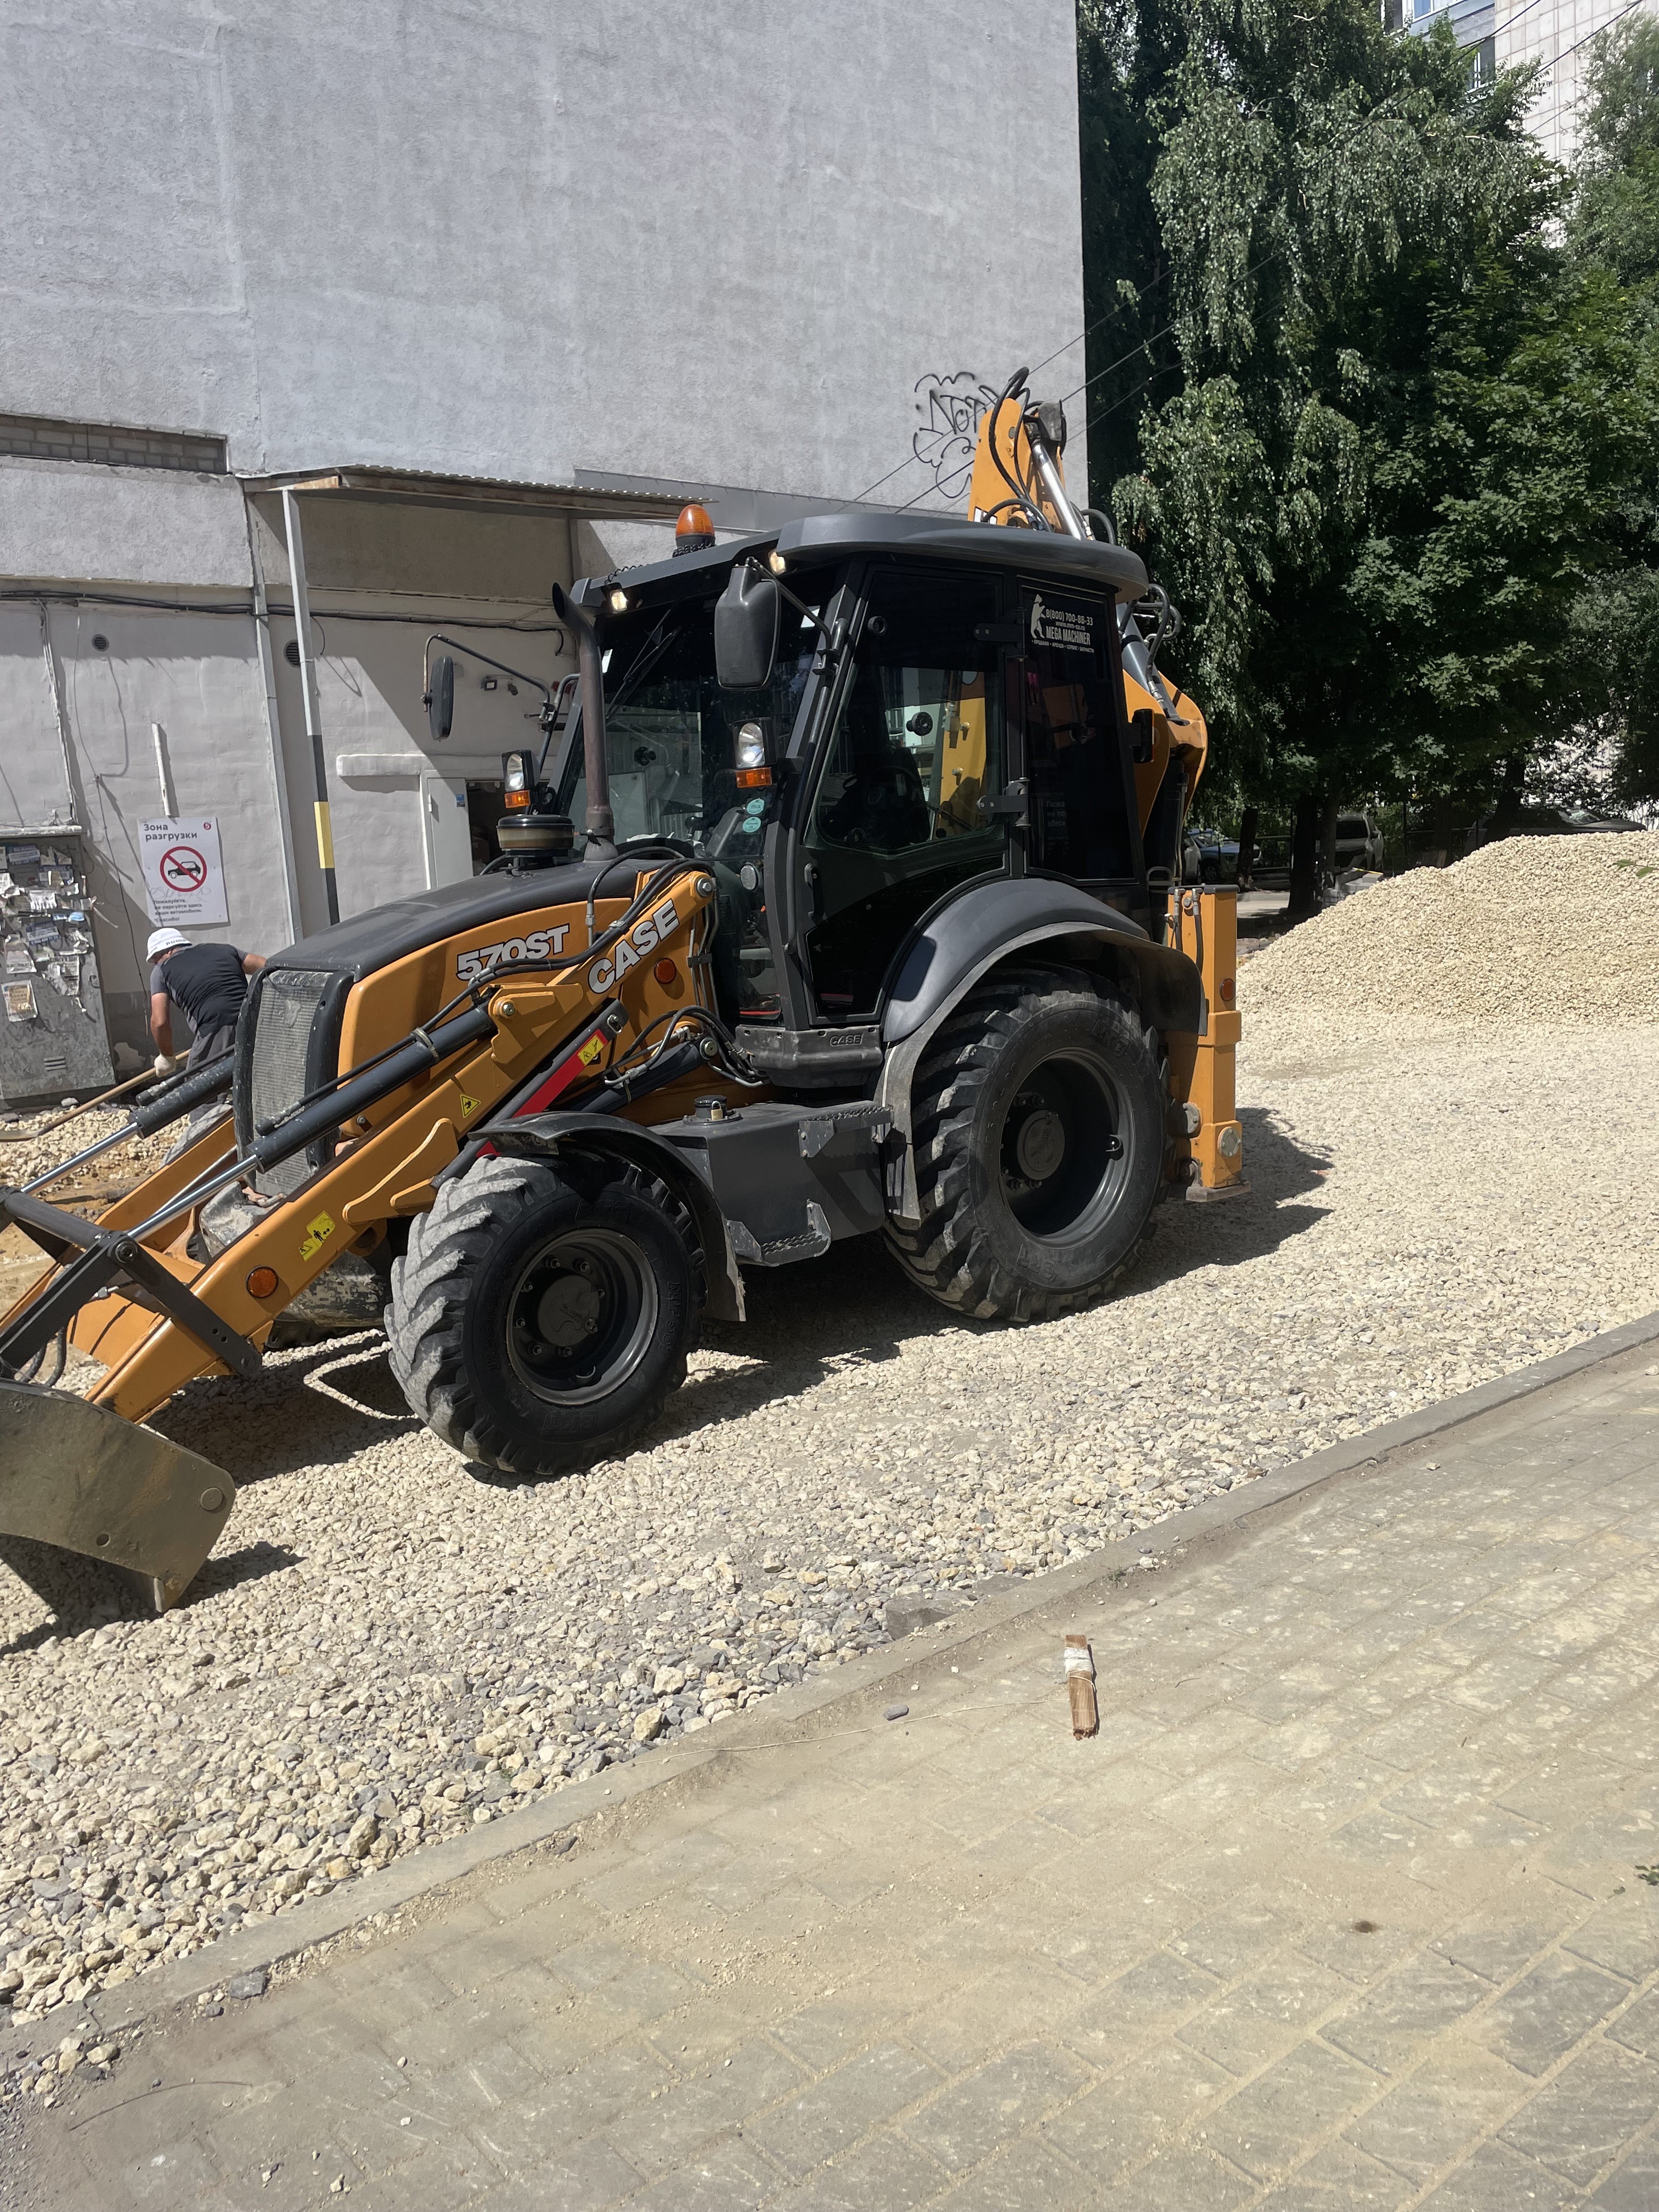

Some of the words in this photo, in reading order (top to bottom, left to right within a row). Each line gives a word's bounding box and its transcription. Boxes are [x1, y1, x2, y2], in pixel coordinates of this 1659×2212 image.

[1045, 608, 1064, 622] 8(800)
[1065, 612, 1093, 626] 700-88-33
[1046, 625, 1062, 641] MEGA
[1063, 629, 1091, 646] MACHINER
[145, 832, 198, 842] разгрузки
[456, 923, 570, 981] 570ST
[588, 899, 680, 994] CASE
[830, 1034, 864, 1047] CASE
